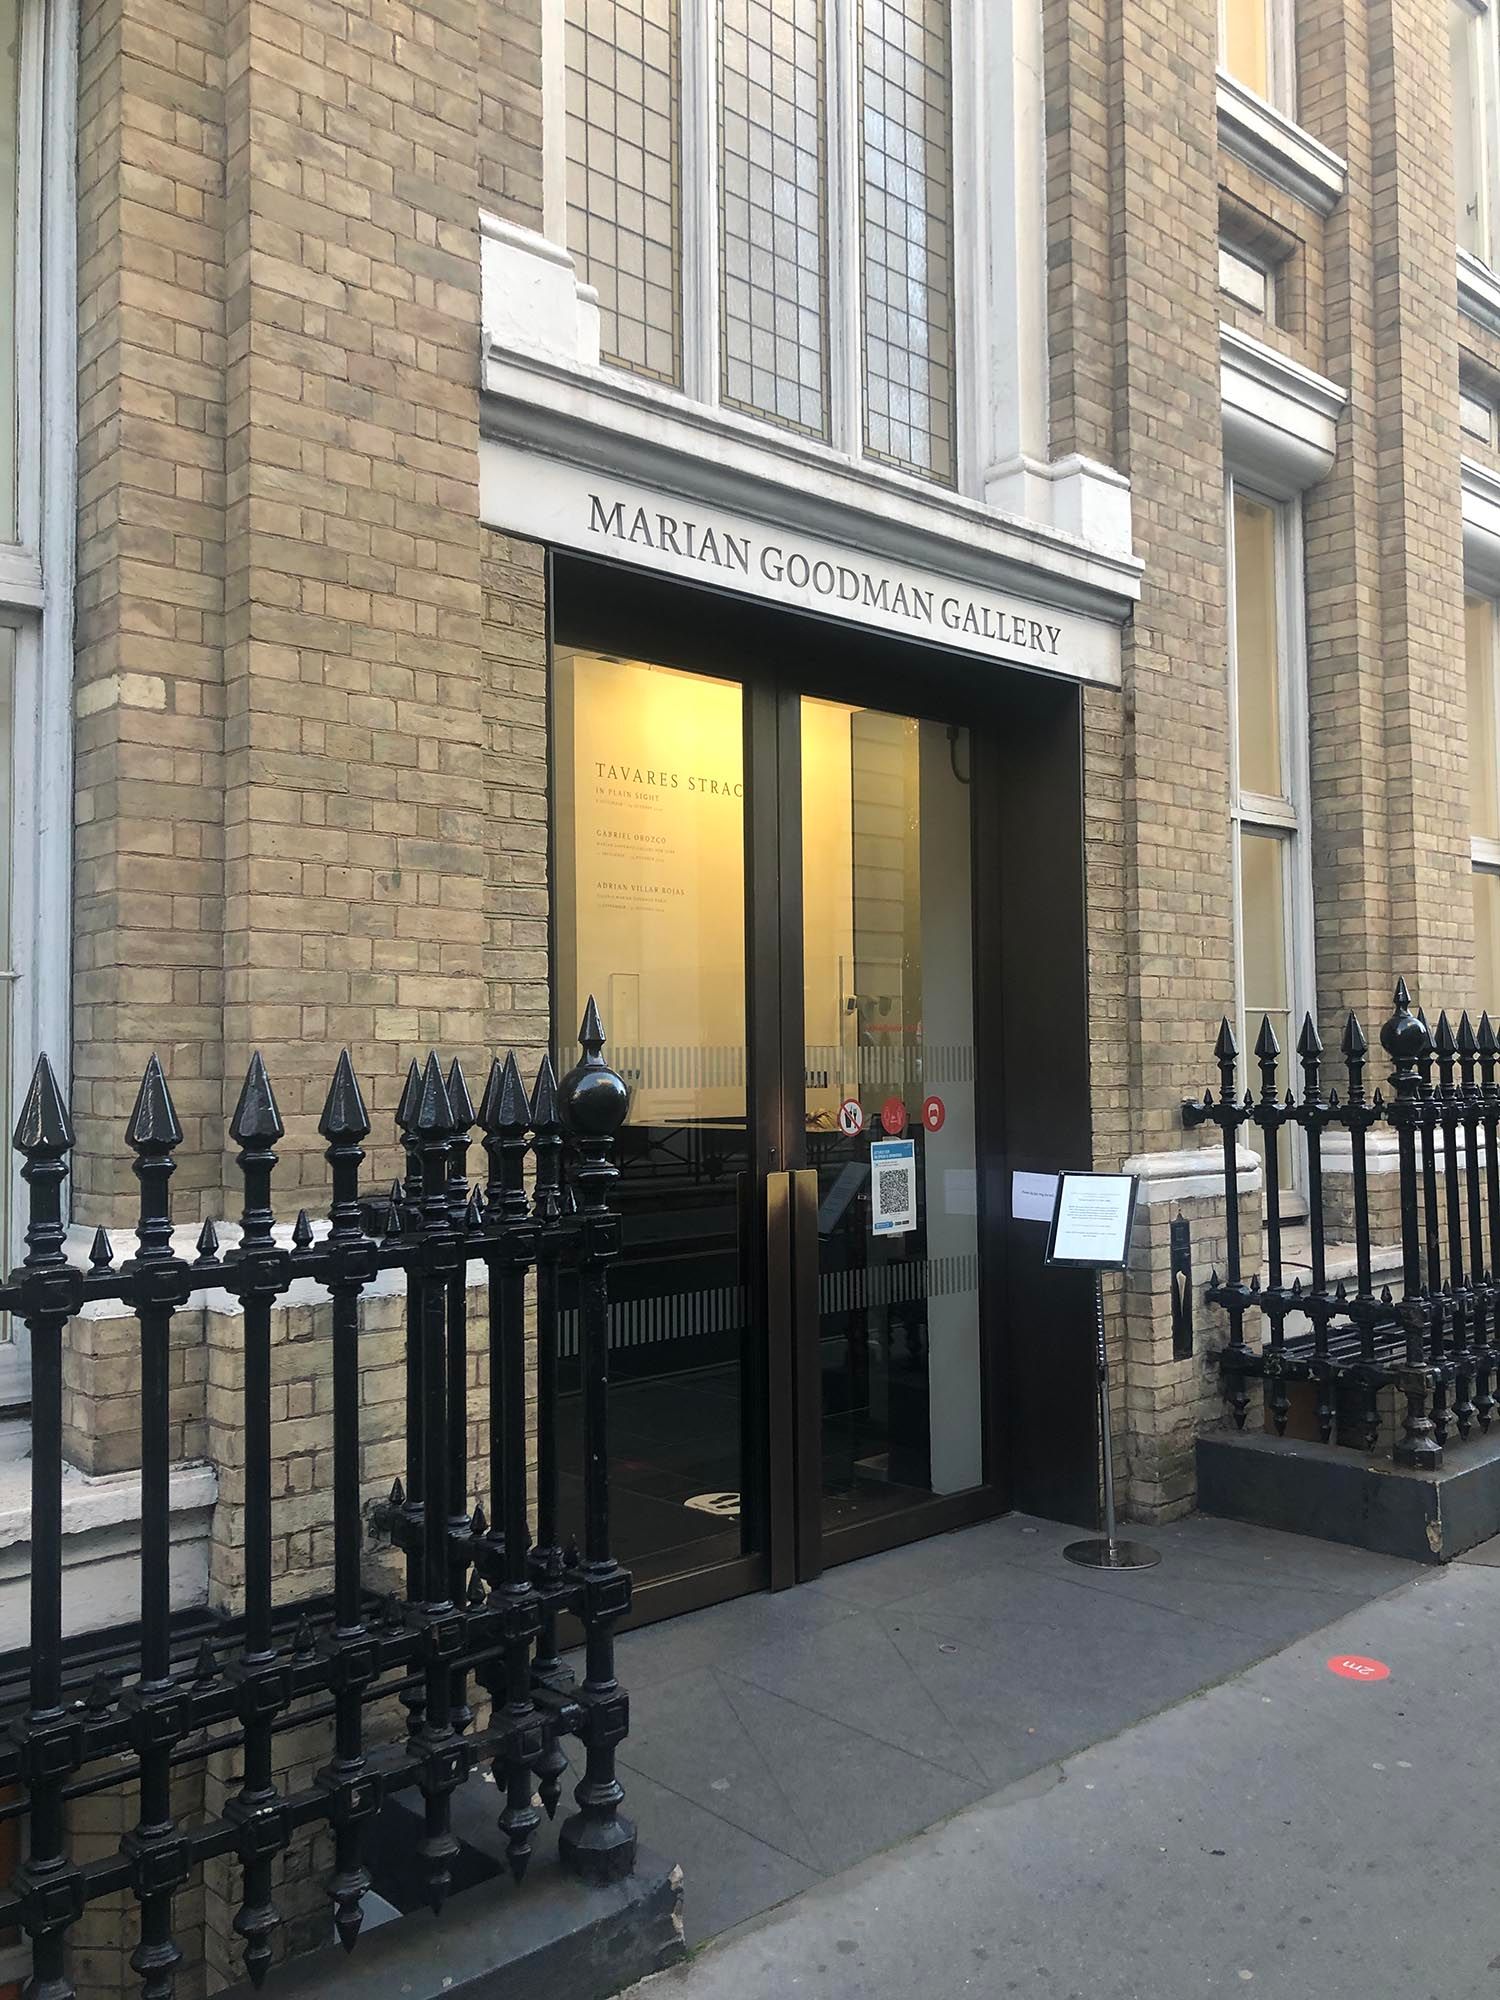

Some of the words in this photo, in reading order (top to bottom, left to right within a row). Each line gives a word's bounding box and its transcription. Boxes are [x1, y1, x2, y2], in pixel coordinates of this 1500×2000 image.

[587, 494, 750, 574] MARIAN
[760, 547, 934, 625] GOODMAN
[941, 599, 1062, 656] GALLERY
[595, 762, 678, 789] TAVARES
[688, 777, 743, 798] STRAC
[635, 793, 660, 802] SIGHT
[596, 829, 632, 841] GABRIEL
[634, 834, 667, 844] OROZCO
[596, 881, 629, 892] ADRIAN
[630, 884, 659, 894] VILLAR
[1343, 1661, 1375, 1675] 2m
